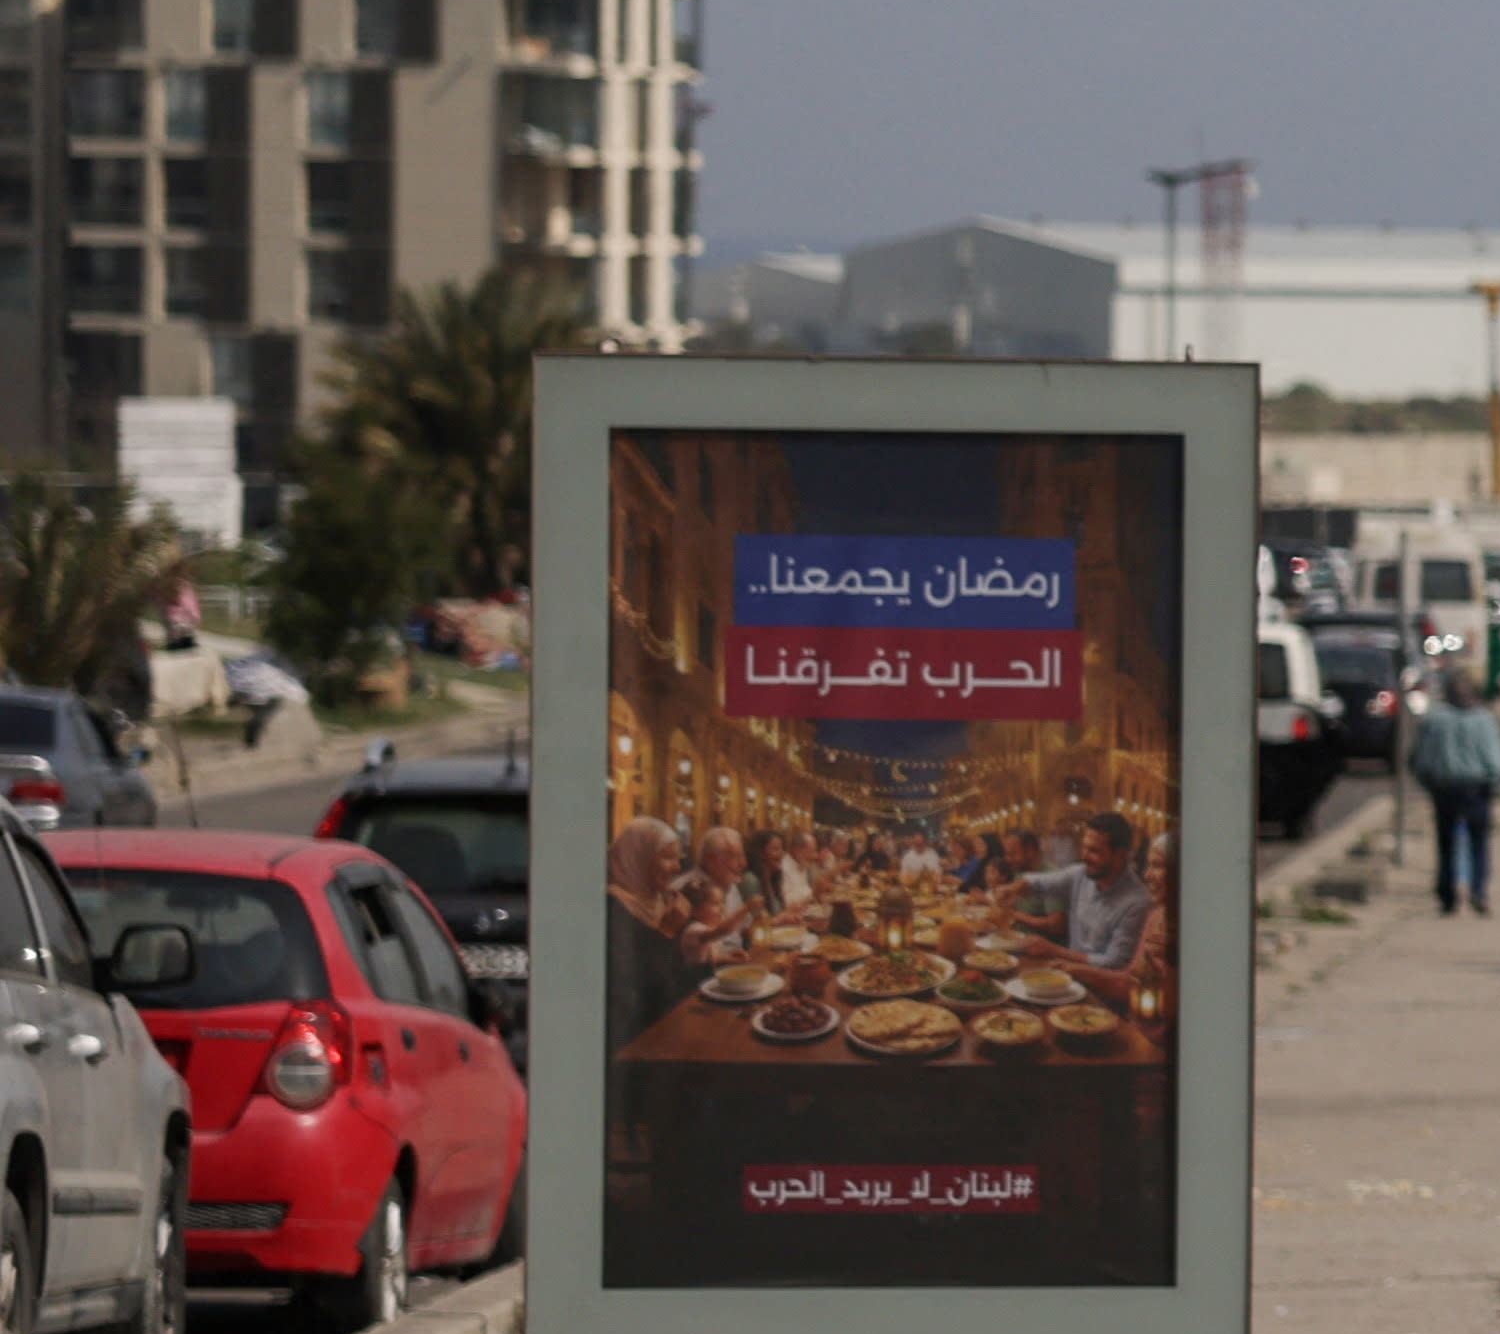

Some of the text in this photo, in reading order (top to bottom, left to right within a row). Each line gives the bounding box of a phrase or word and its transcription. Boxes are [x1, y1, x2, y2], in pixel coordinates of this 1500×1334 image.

[748, 553, 1061, 609] رمضان يجمعنا..
[744, 643, 1063, 699] الحرب تفرقنا
